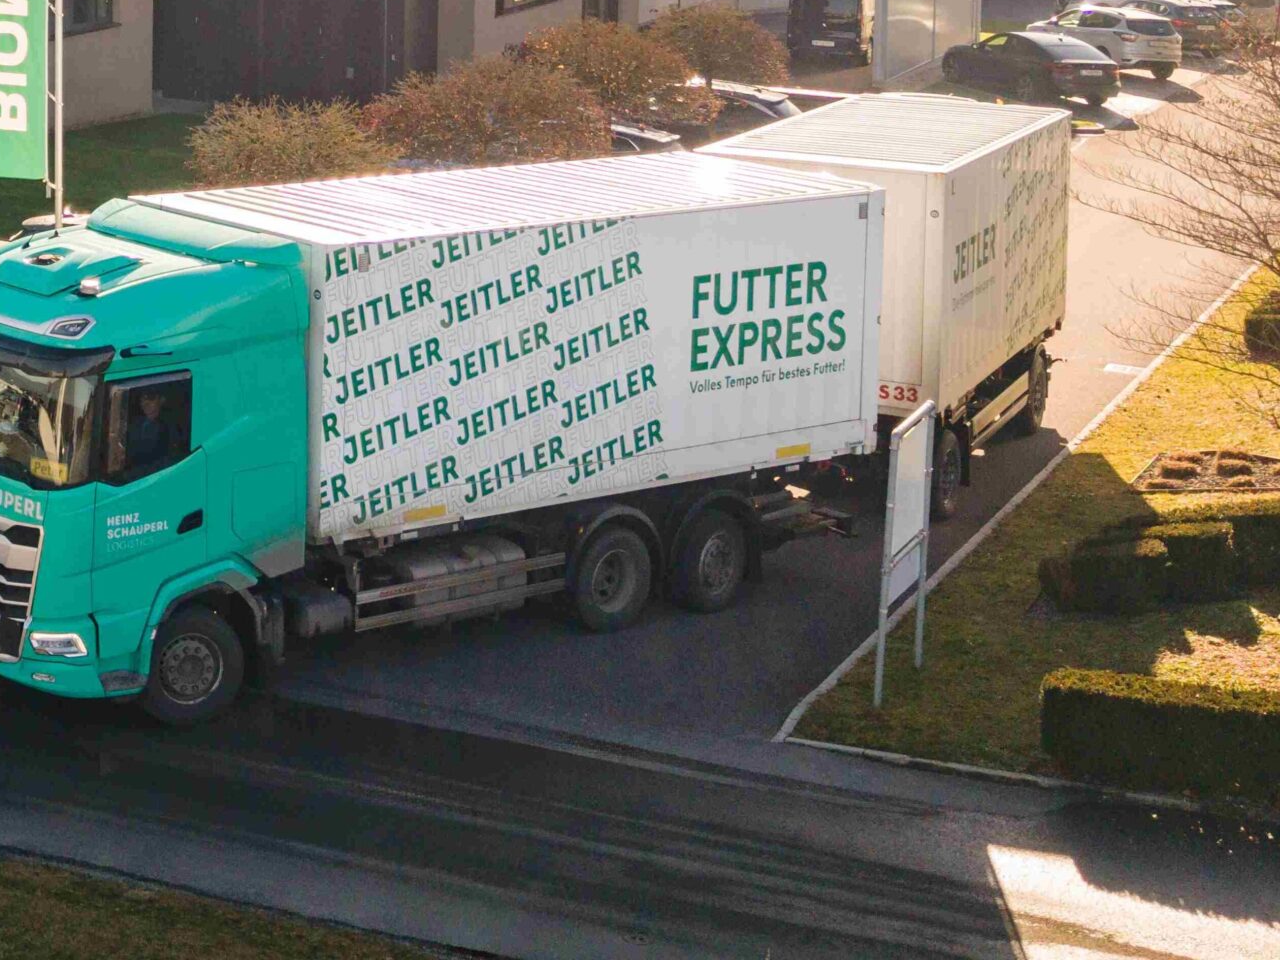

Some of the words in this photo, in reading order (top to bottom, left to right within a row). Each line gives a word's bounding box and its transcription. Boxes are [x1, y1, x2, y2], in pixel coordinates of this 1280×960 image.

[953, 223, 996, 285] JEITLER
[326, 278, 435, 344] JEITLER
[440, 263, 543, 329] JEITLER
[692, 261, 827, 319] FUTTER
[335, 337, 443, 405] JEITLER
[545, 250, 642, 314] JEITLER
[448, 320, 551, 386] JEITLER
[690, 309, 846, 372] EXPRESS
[343, 396, 451, 464] JEITLER
[553, 307, 650, 371] JEITLER
[690, 379, 722, 393] Volles
[725, 374, 759, 390] Tempo
[762, 370, 776, 383] für
[778, 367, 811, 381] bestes
[813, 359, 846, 376] Futter!
[893, 386, 918, 403] 33
[352, 455, 459, 524] JEITLER
[560, 363, 657, 428] JEITLER
[456, 379, 558, 445] JEITLER
[34, 460, 64, 481] Petr
[464, 435, 566, 503] JEITLER
[567, 419, 664, 485] JEITLER
[107, 512, 140, 527] HEINZ
[107, 520, 169, 540] SCHAUPERL
